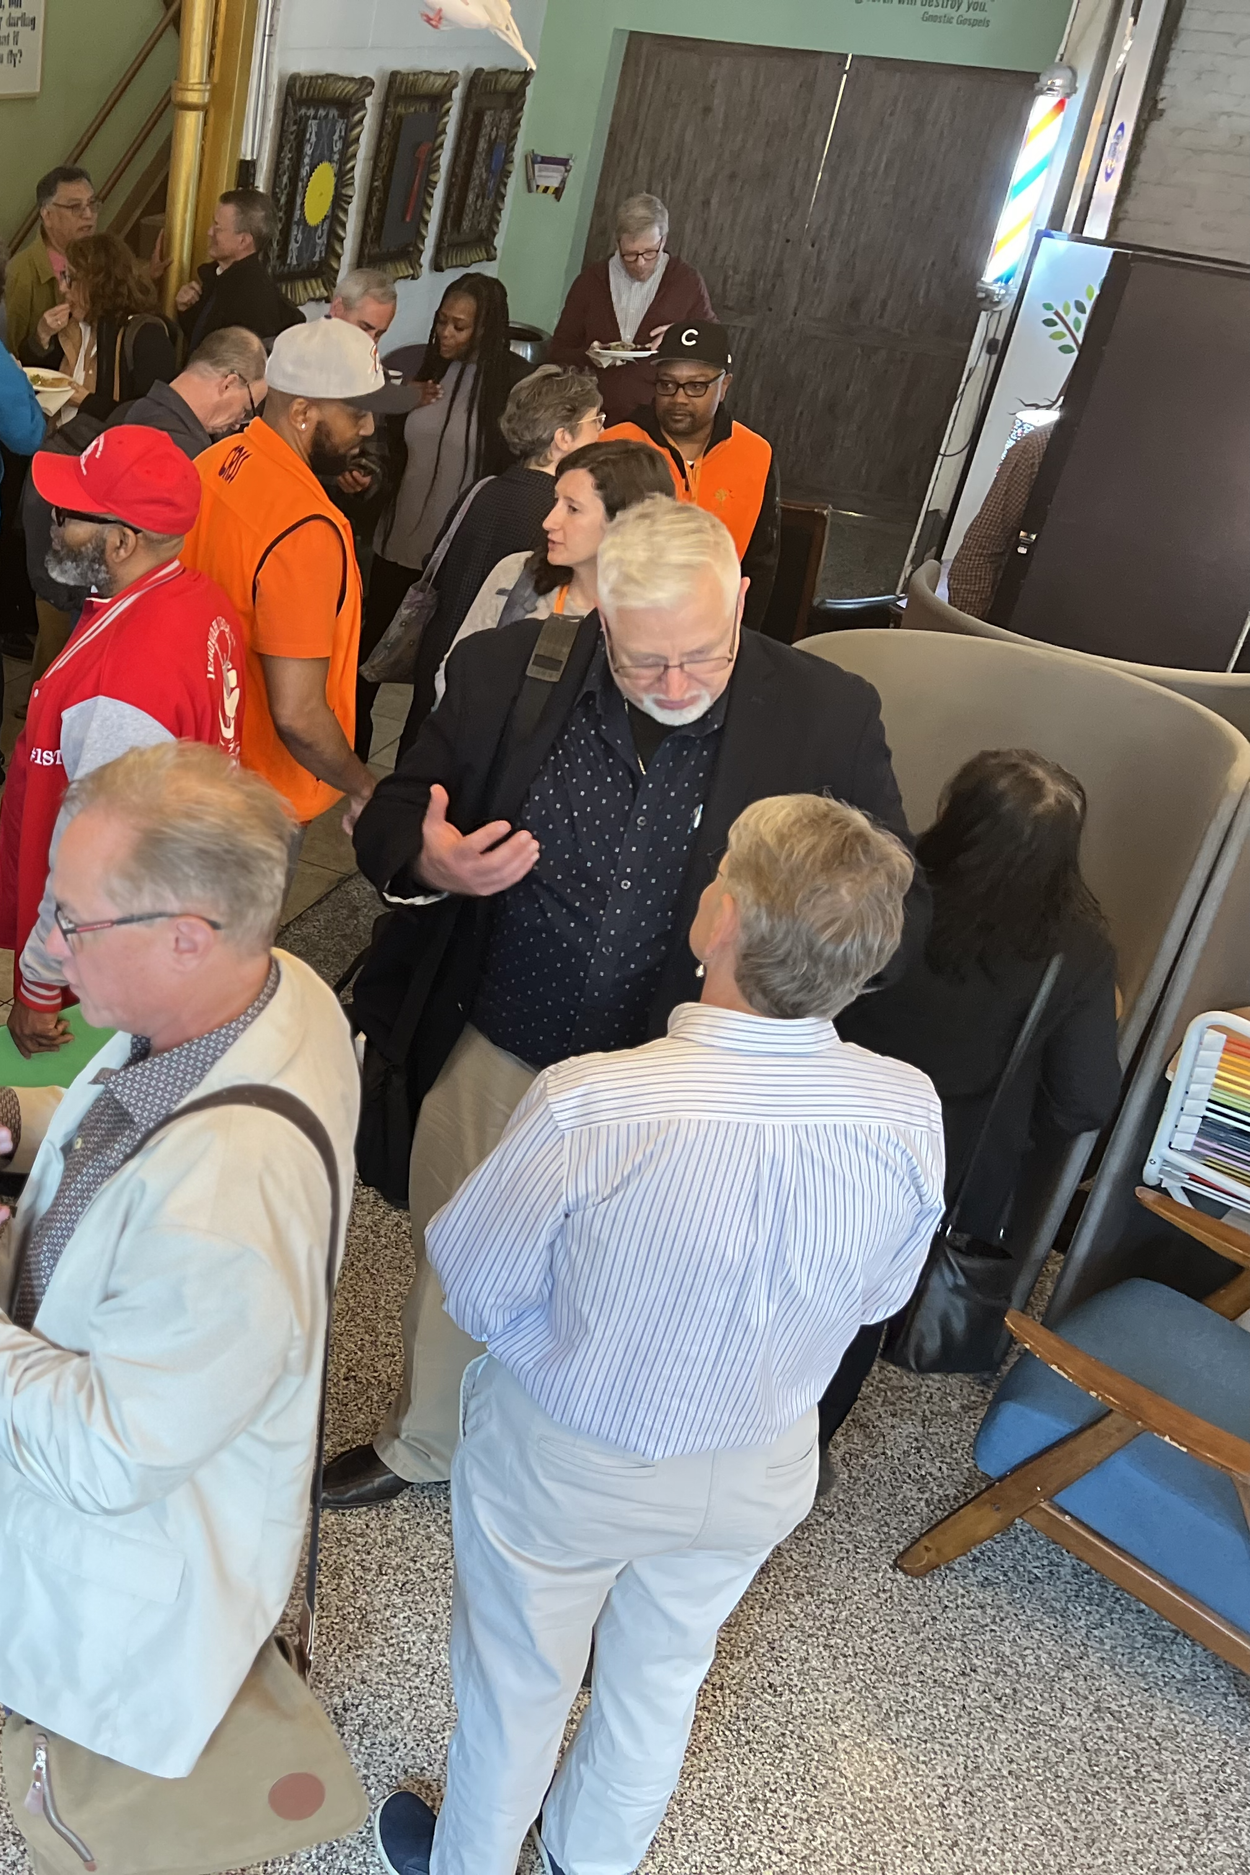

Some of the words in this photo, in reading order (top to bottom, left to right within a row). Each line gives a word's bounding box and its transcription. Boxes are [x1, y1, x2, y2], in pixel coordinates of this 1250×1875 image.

[6, 12, 36, 31] darling
[922, 11, 954, 25] Gnostic
[956, 14, 991, 28] Gospels
[13, 30, 20, 46] if
[7, 49, 23, 68] fly?
[681, 328, 699, 346] C
